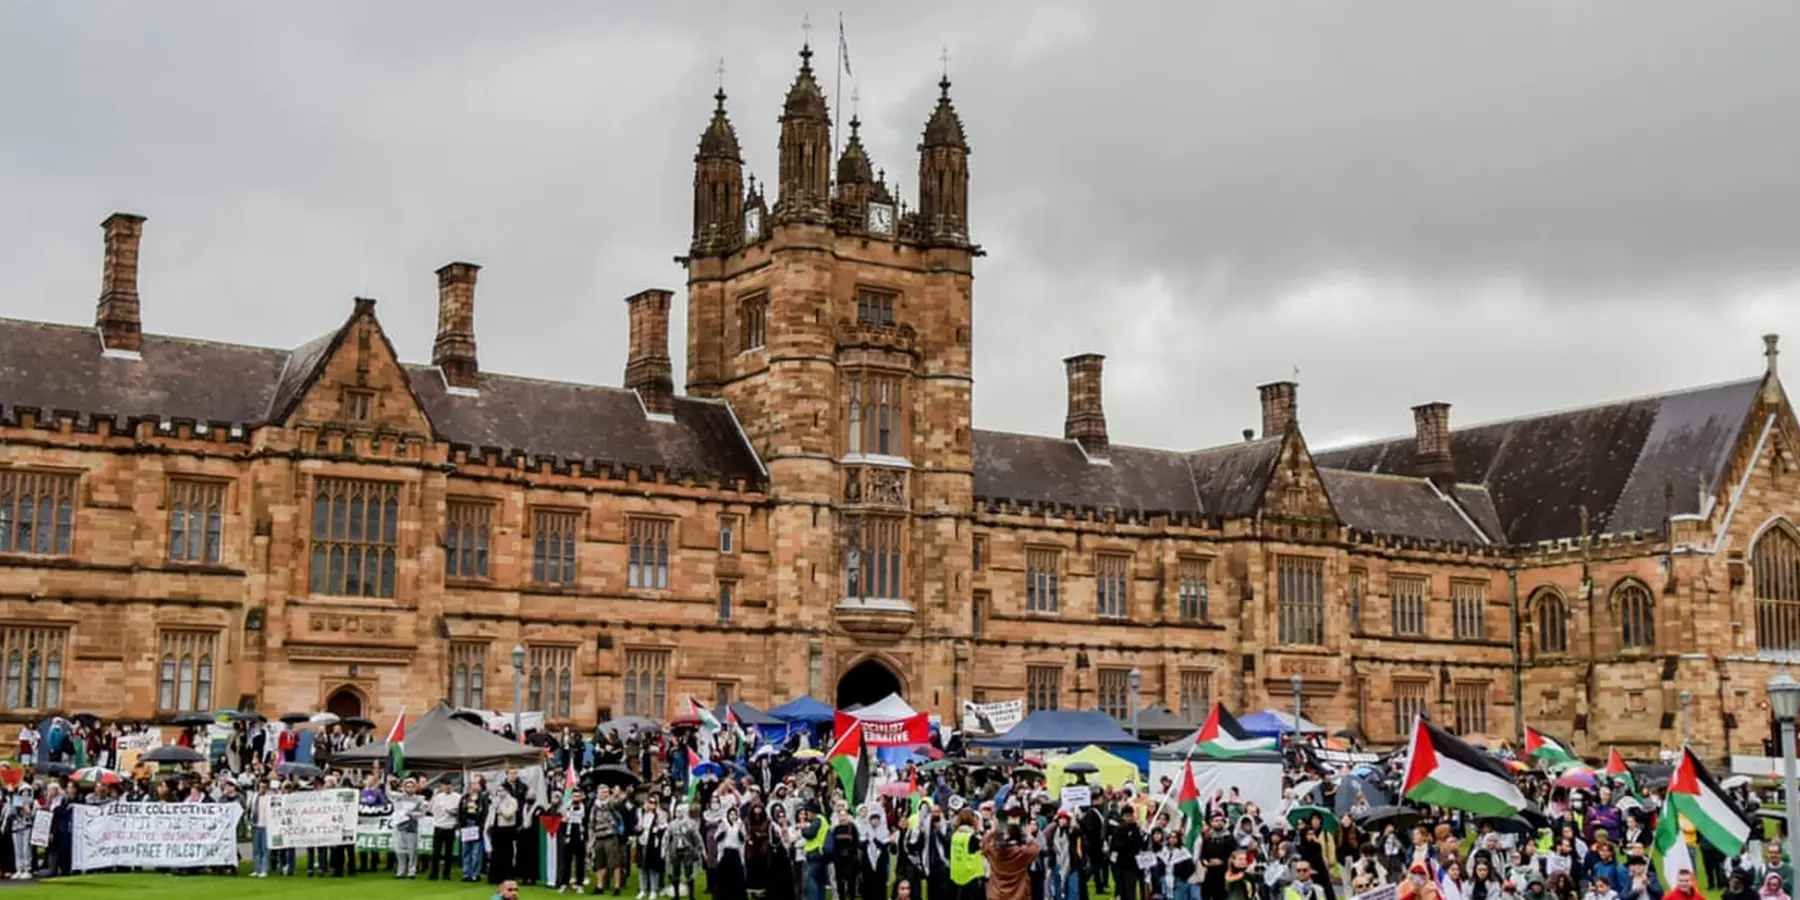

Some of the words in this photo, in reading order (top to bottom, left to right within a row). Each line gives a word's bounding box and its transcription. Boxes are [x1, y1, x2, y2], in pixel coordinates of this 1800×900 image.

[862, 722, 904, 733] OCIALIST
[864, 731, 909, 742] ERNATIVE
[145, 803, 216, 815] COLLECTIVE
[136, 842, 162, 858] FREE
